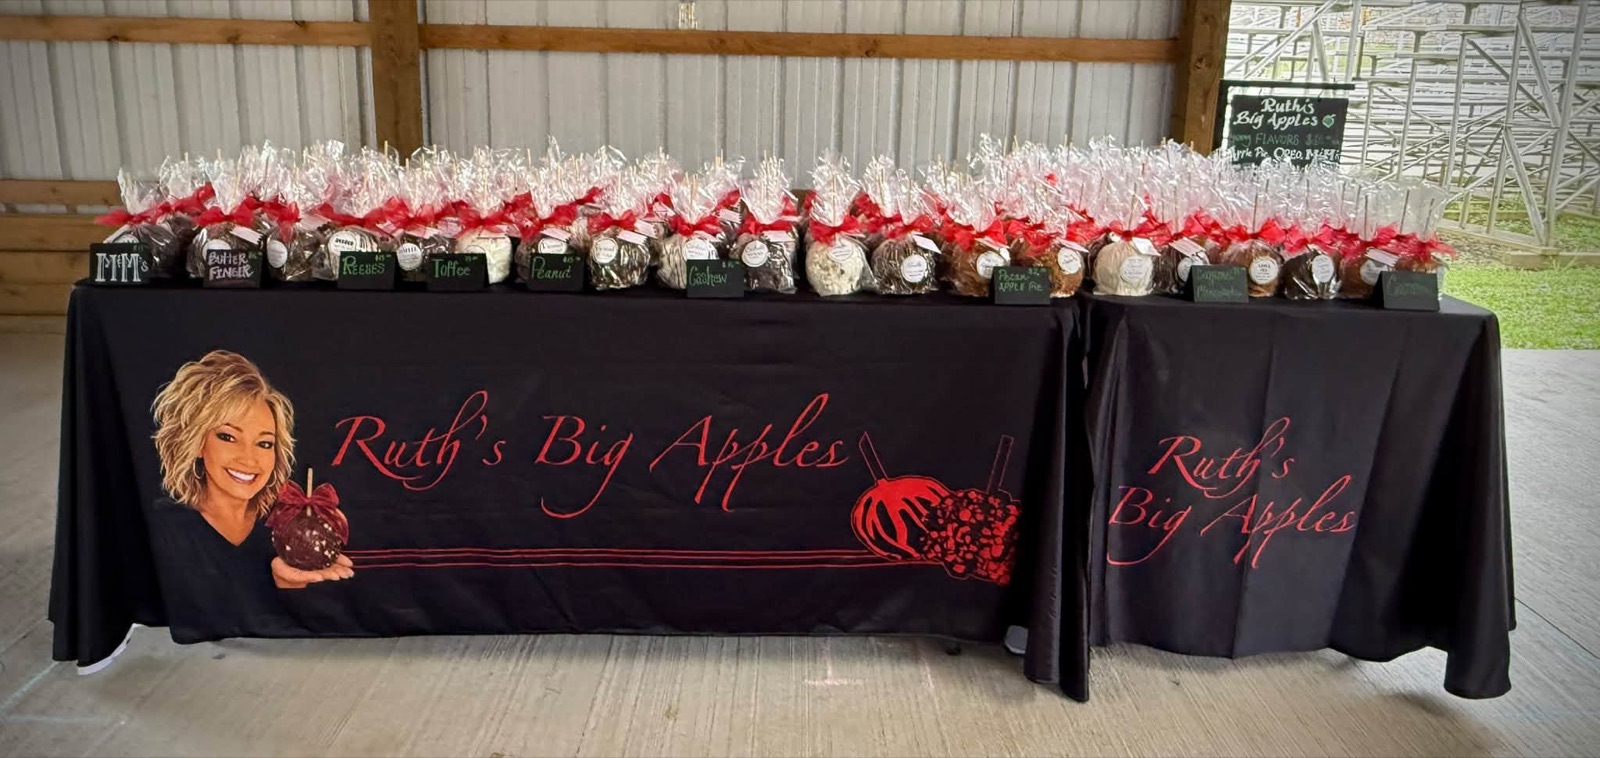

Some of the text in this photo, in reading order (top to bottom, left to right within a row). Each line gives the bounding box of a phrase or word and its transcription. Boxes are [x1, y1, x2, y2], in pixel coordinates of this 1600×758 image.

[1232, 111, 1318, 130] Big Apples
[1255, 132, 1300, 146] FLAVORS
[208, 258, 254, 275] FINGER
[431, 258, 471, 279] Toffee
[531, 255, 572, 280] Peanut
[688, 265, 728, 287] Cashew
[998, 268, 1030, 281] Pecan
[331, 390, 849, 518] Ruth's Big Apples
[1147, 416, 1295, 499] Ruth's
[1106, 474, 1356, 569] Big Apples
